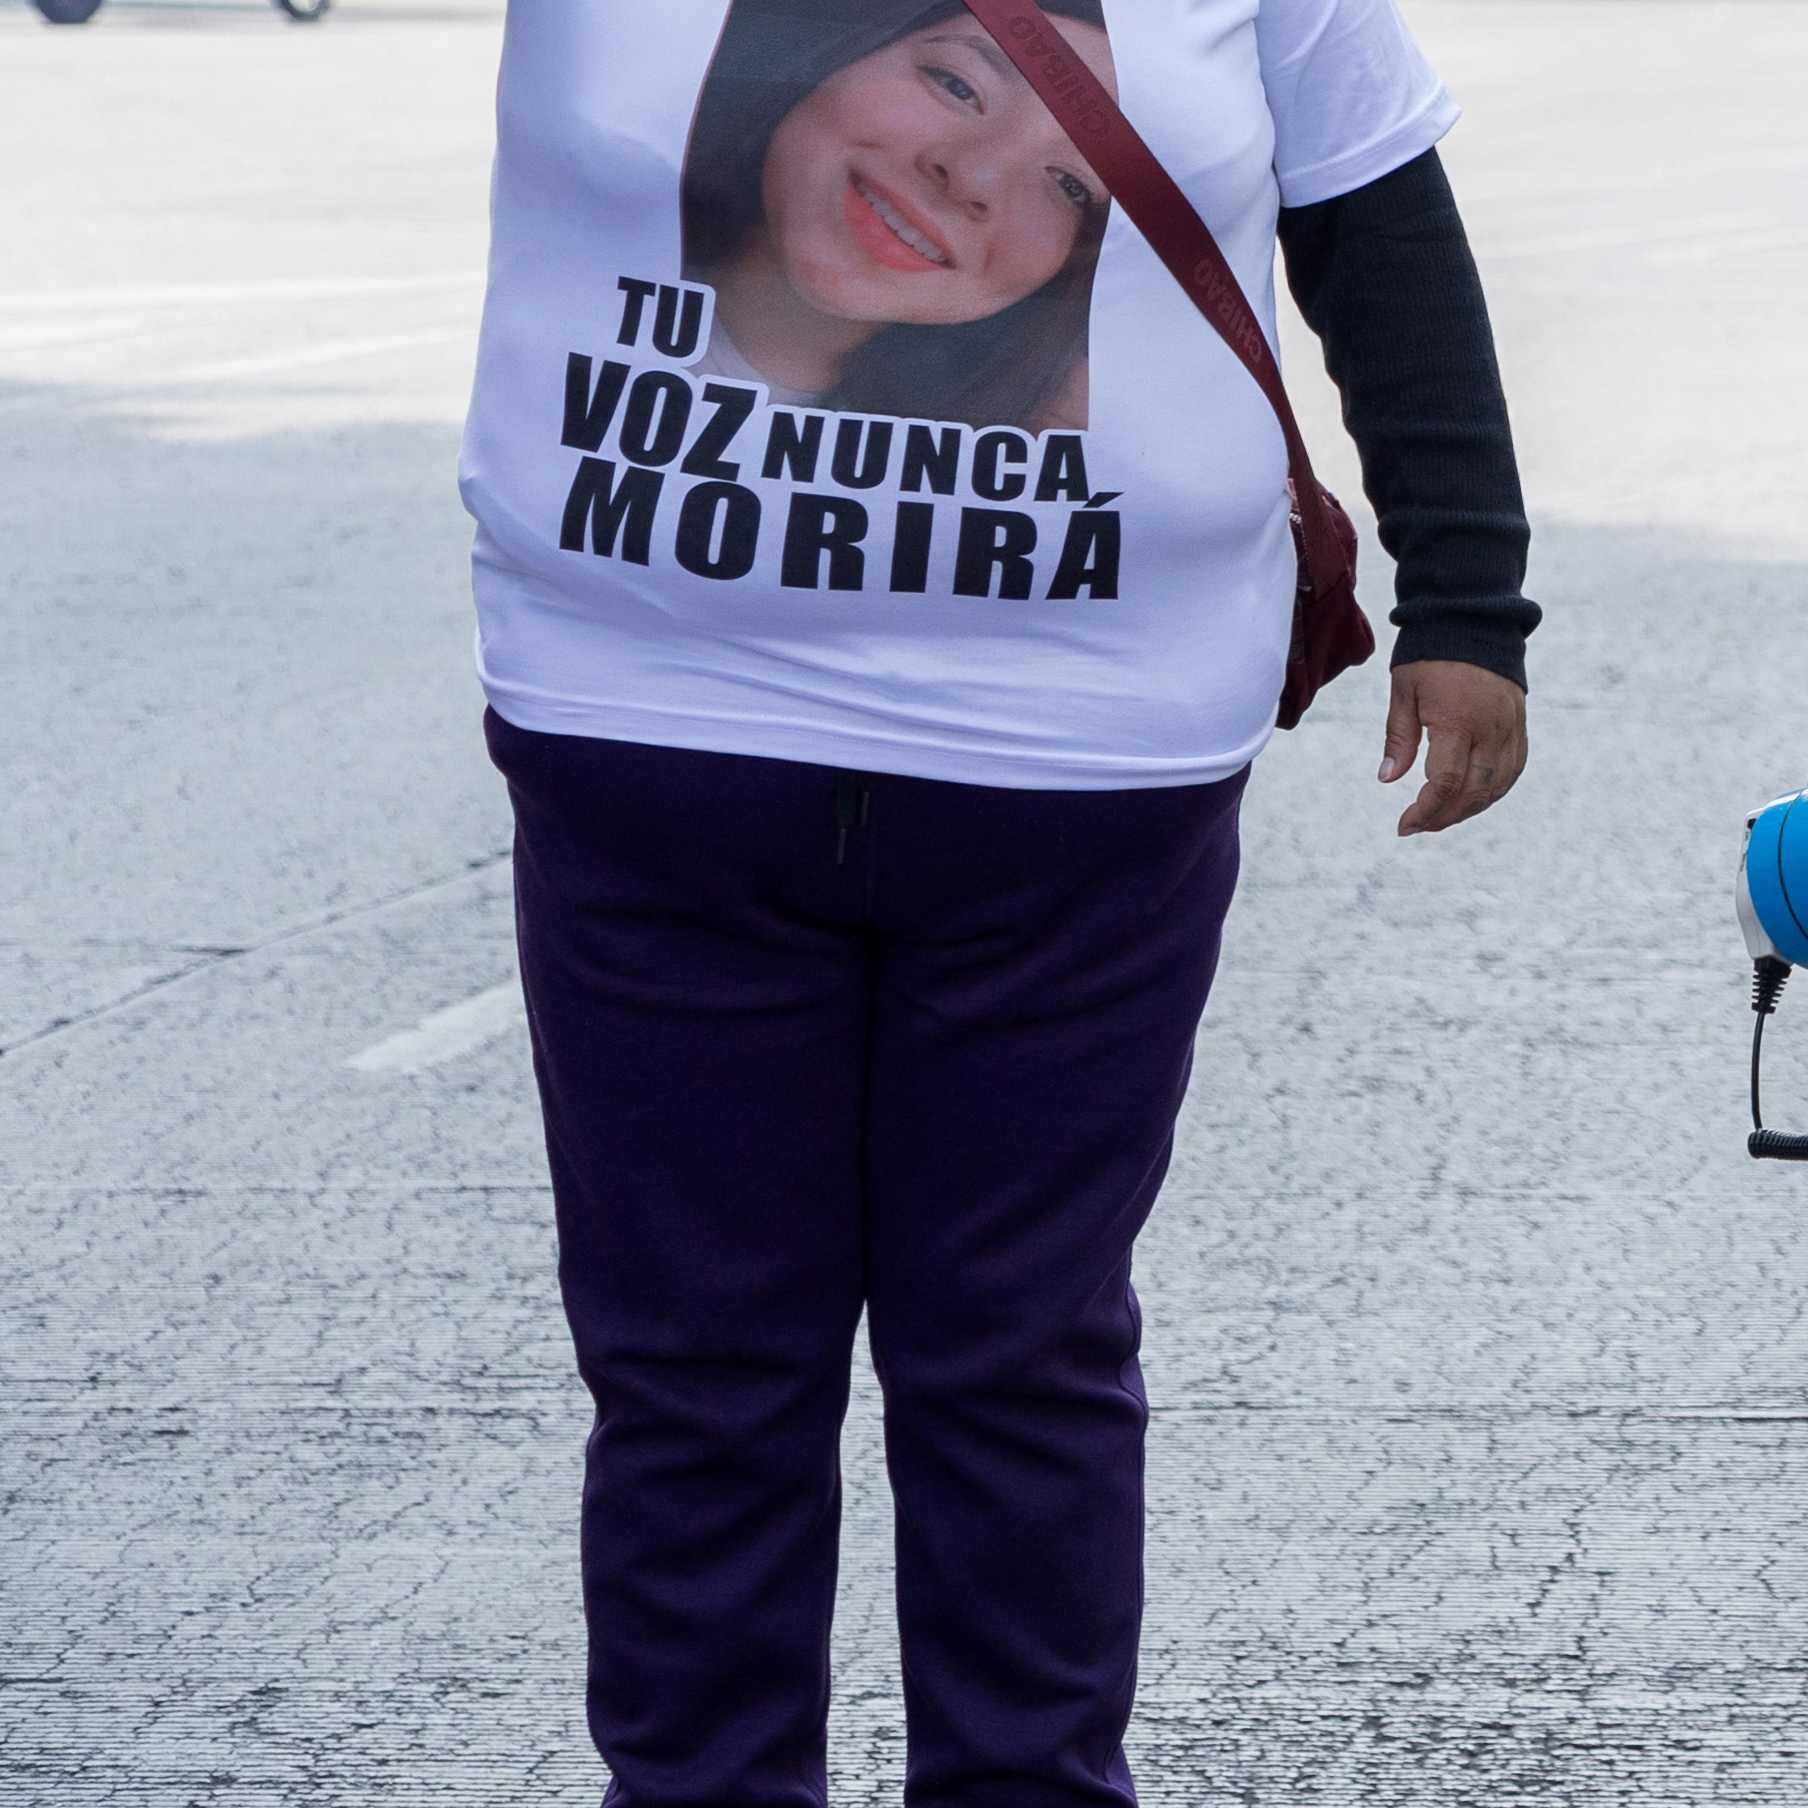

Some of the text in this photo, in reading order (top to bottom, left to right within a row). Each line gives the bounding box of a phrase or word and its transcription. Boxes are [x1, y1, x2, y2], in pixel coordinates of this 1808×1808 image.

[616, 276, 705, 359] TU
[560, 352, 1089, 502] VOZ NUNCA
[559, 455, 1125, 601] MORIRÁ
